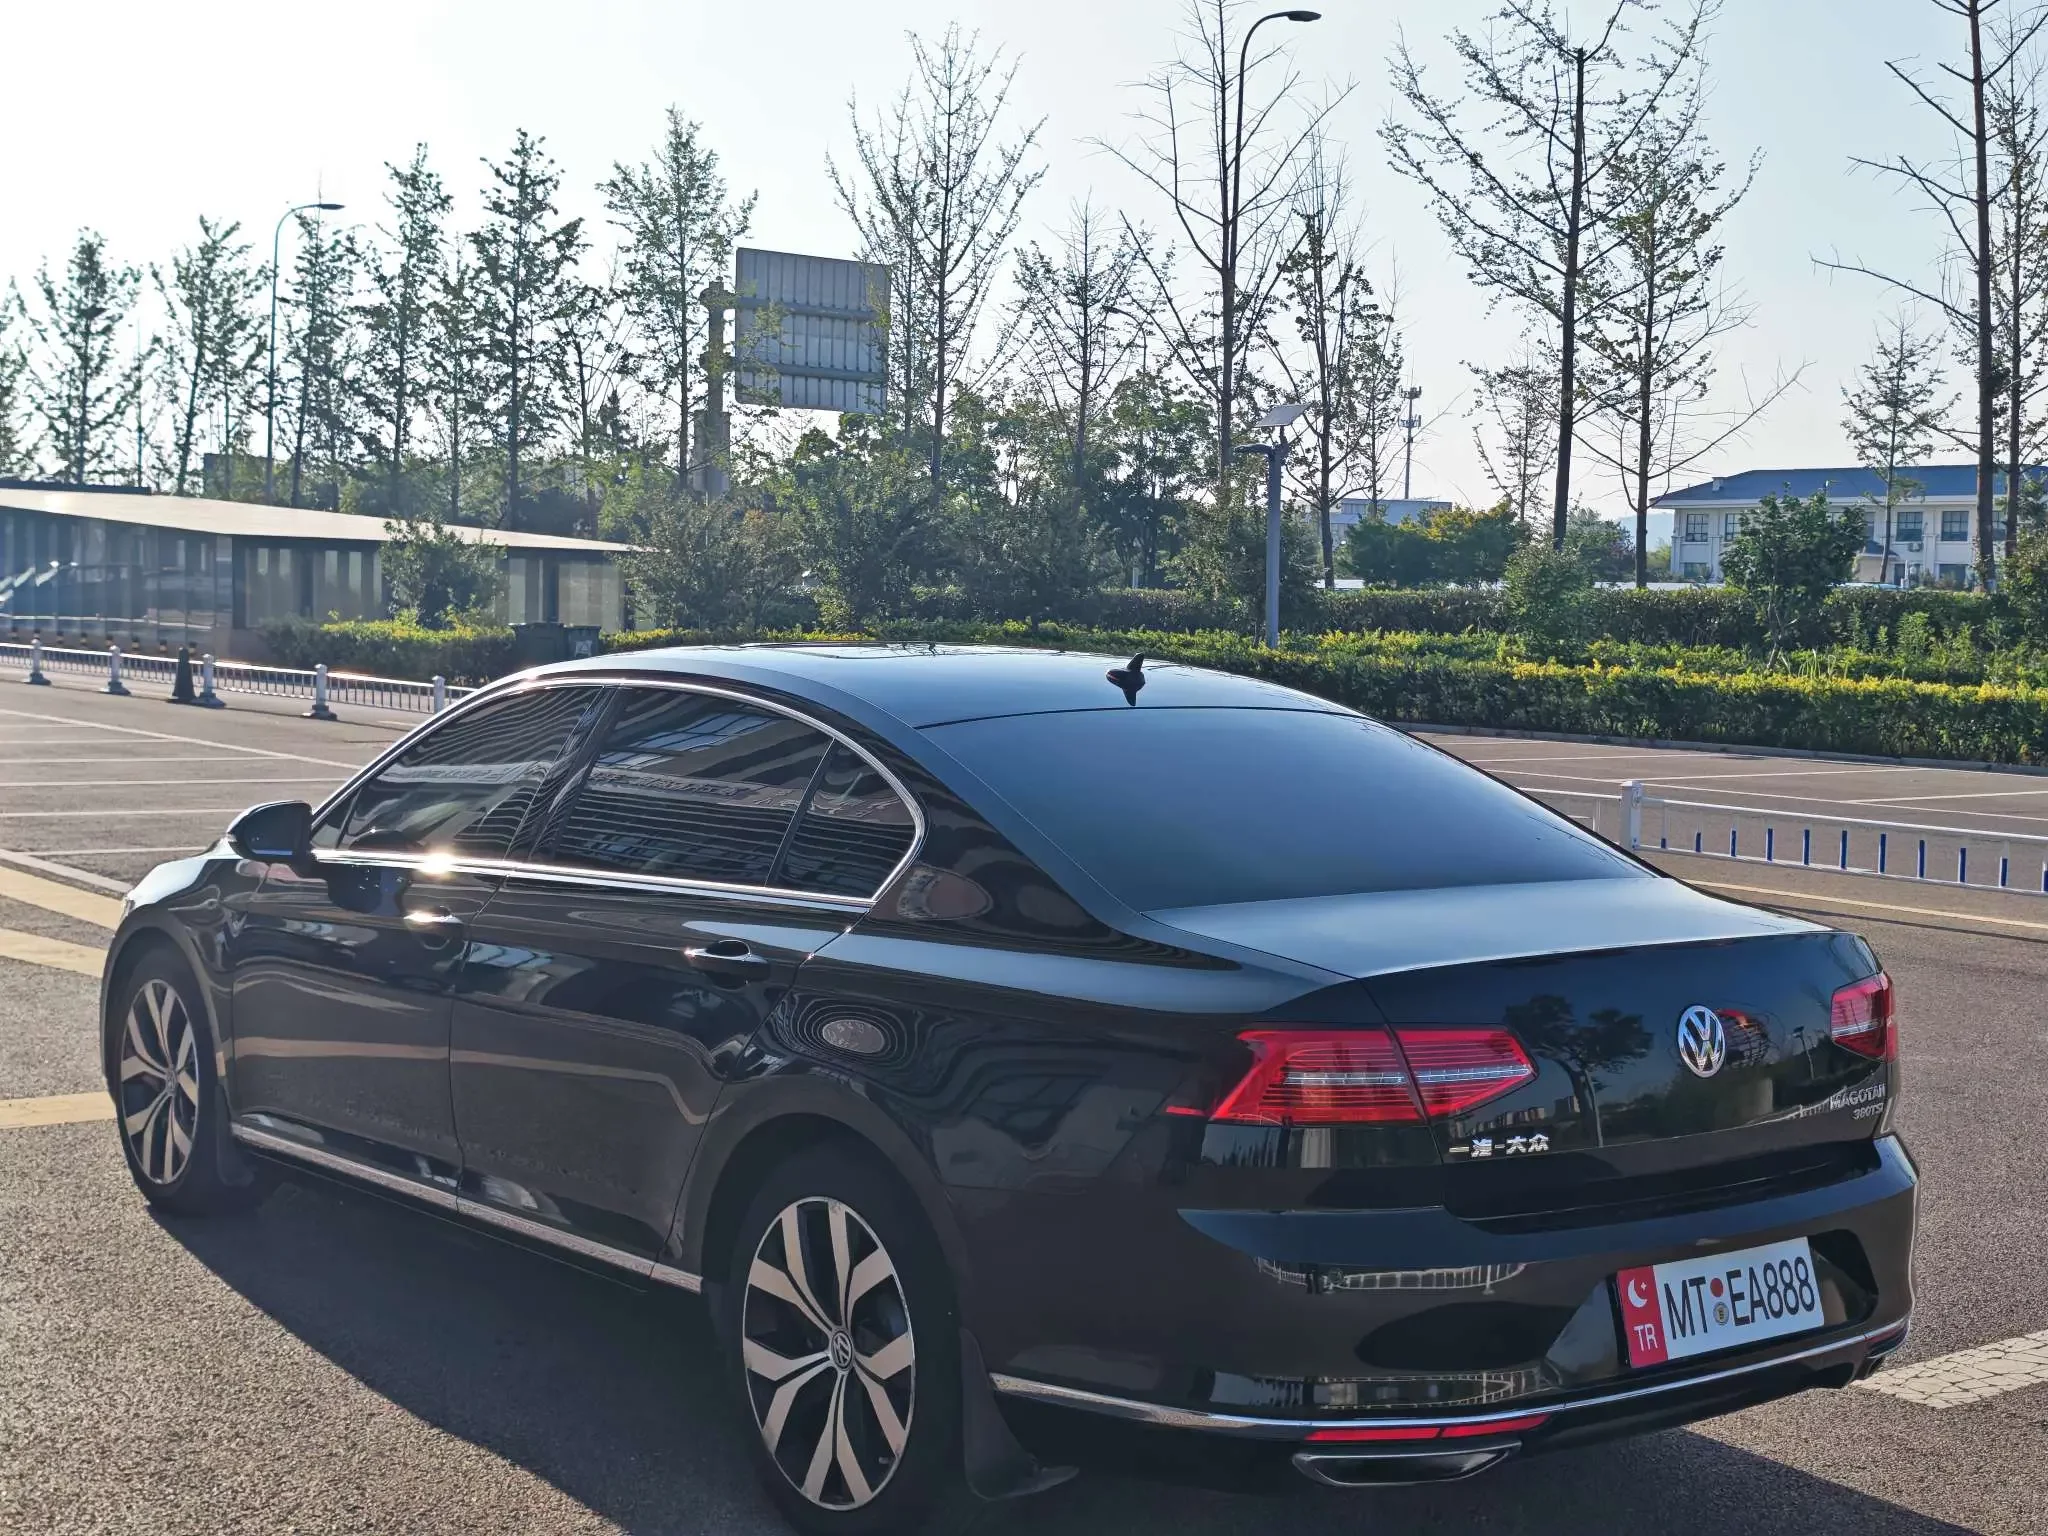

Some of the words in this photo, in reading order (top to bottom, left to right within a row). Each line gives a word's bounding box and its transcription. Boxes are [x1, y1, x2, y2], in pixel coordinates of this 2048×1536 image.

[1830, 1083, 1886, 1110] MAGOTAN
[1663, 1276, 1708, 1340] MT
[1726, 1256, 1815, 1326] EA888
[1634, 1323, 1658, 1352] TR
